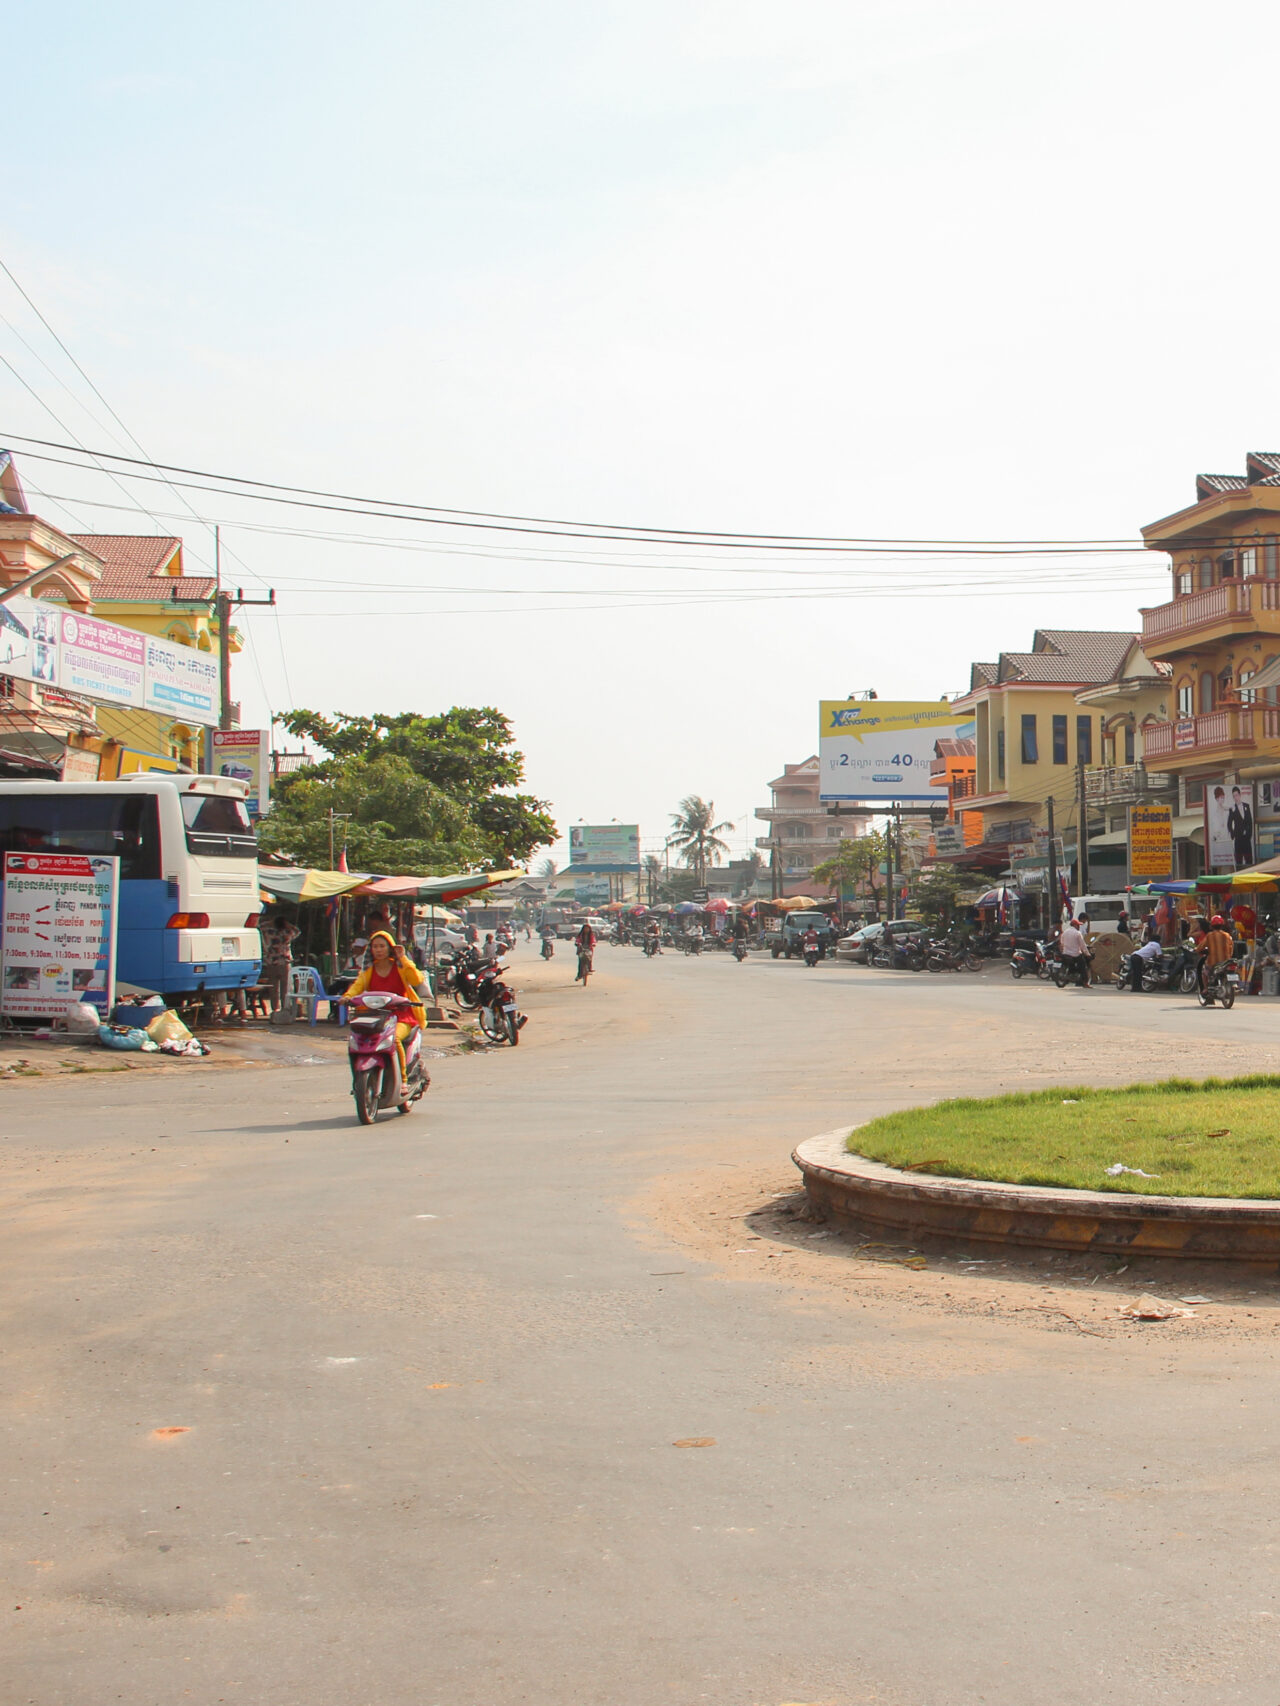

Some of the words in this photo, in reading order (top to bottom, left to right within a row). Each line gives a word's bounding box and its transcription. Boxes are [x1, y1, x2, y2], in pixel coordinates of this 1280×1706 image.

[78, 637, 99, 650] OLYMPIC
[99, 641, 125, 656] TRANSPORT
[72, 675, 85, 686] BUS
[86, 679, 105, 690] TICKET
[107, 683, 132, 697] COUNTER
[839, 753, 849, 766] 2
[891, 753, 913, 766] 40
